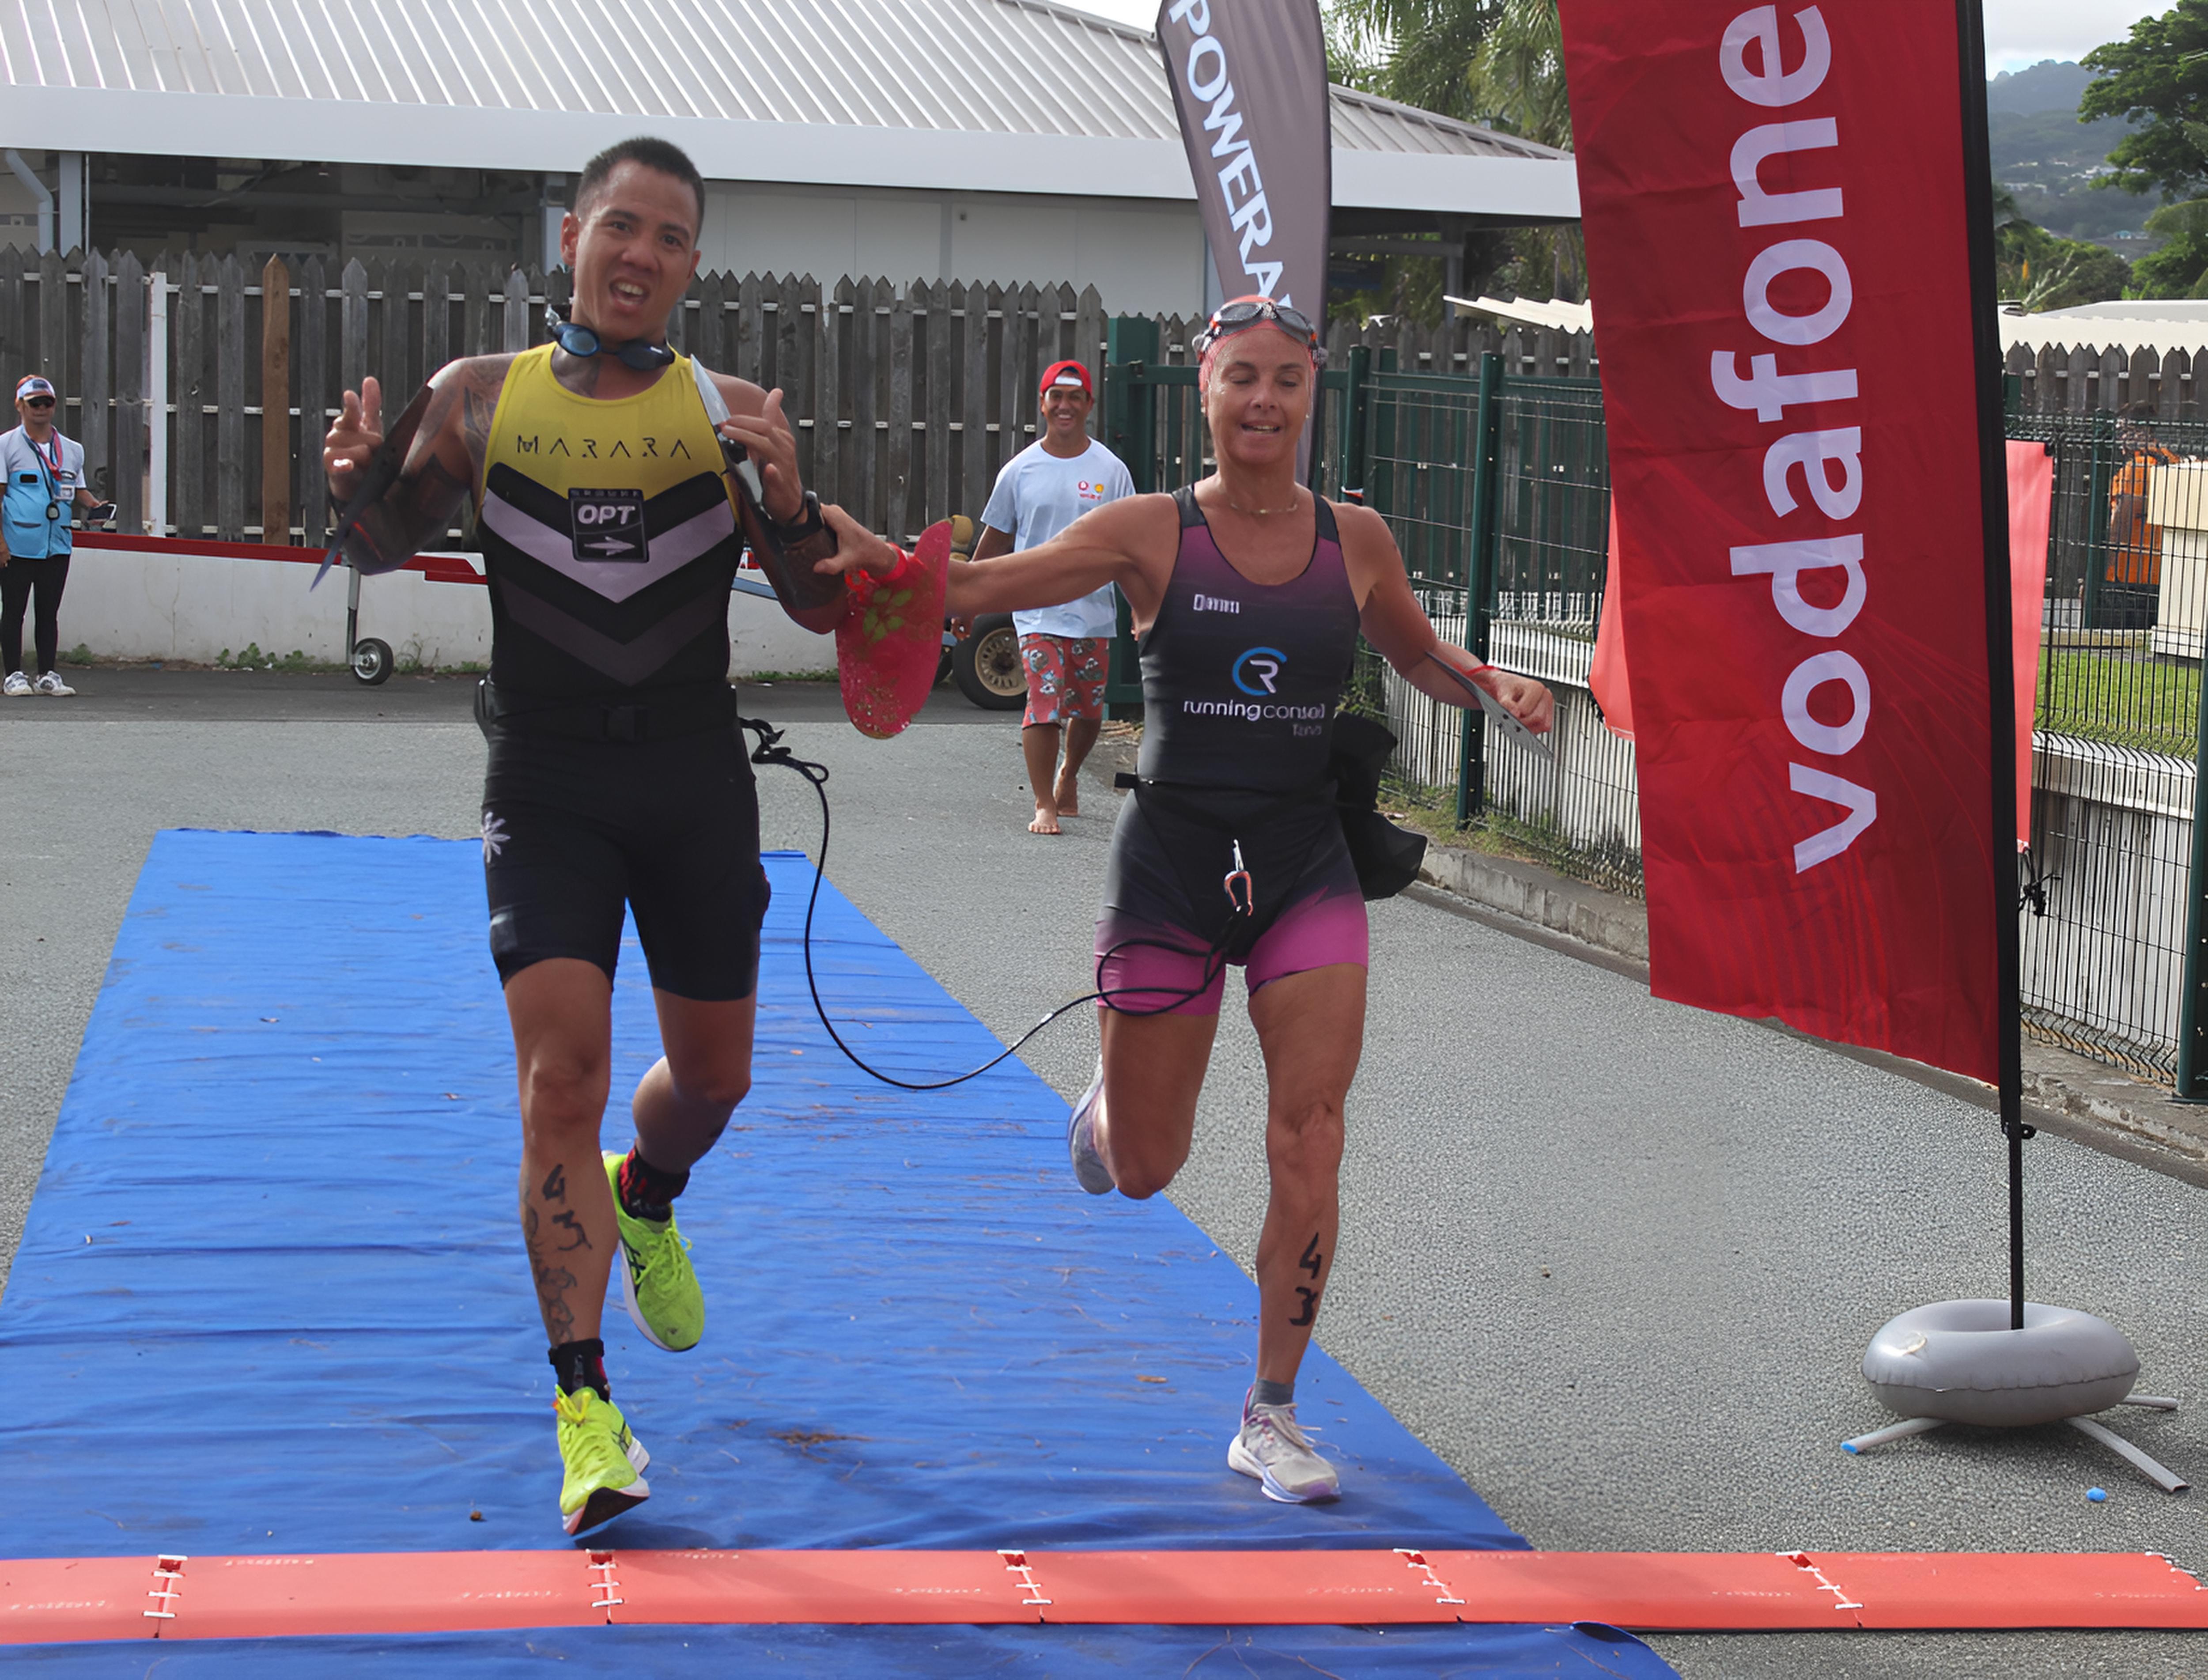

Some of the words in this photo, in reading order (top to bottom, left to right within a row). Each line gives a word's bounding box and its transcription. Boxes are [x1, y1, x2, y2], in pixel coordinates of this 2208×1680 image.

[1168, 0, 1293, 308] POWERA
[517, 435, 691, 460] MARARA
[578, 504, 635, 525] OPT
[1710, 4, 1877, 874] vodafone
